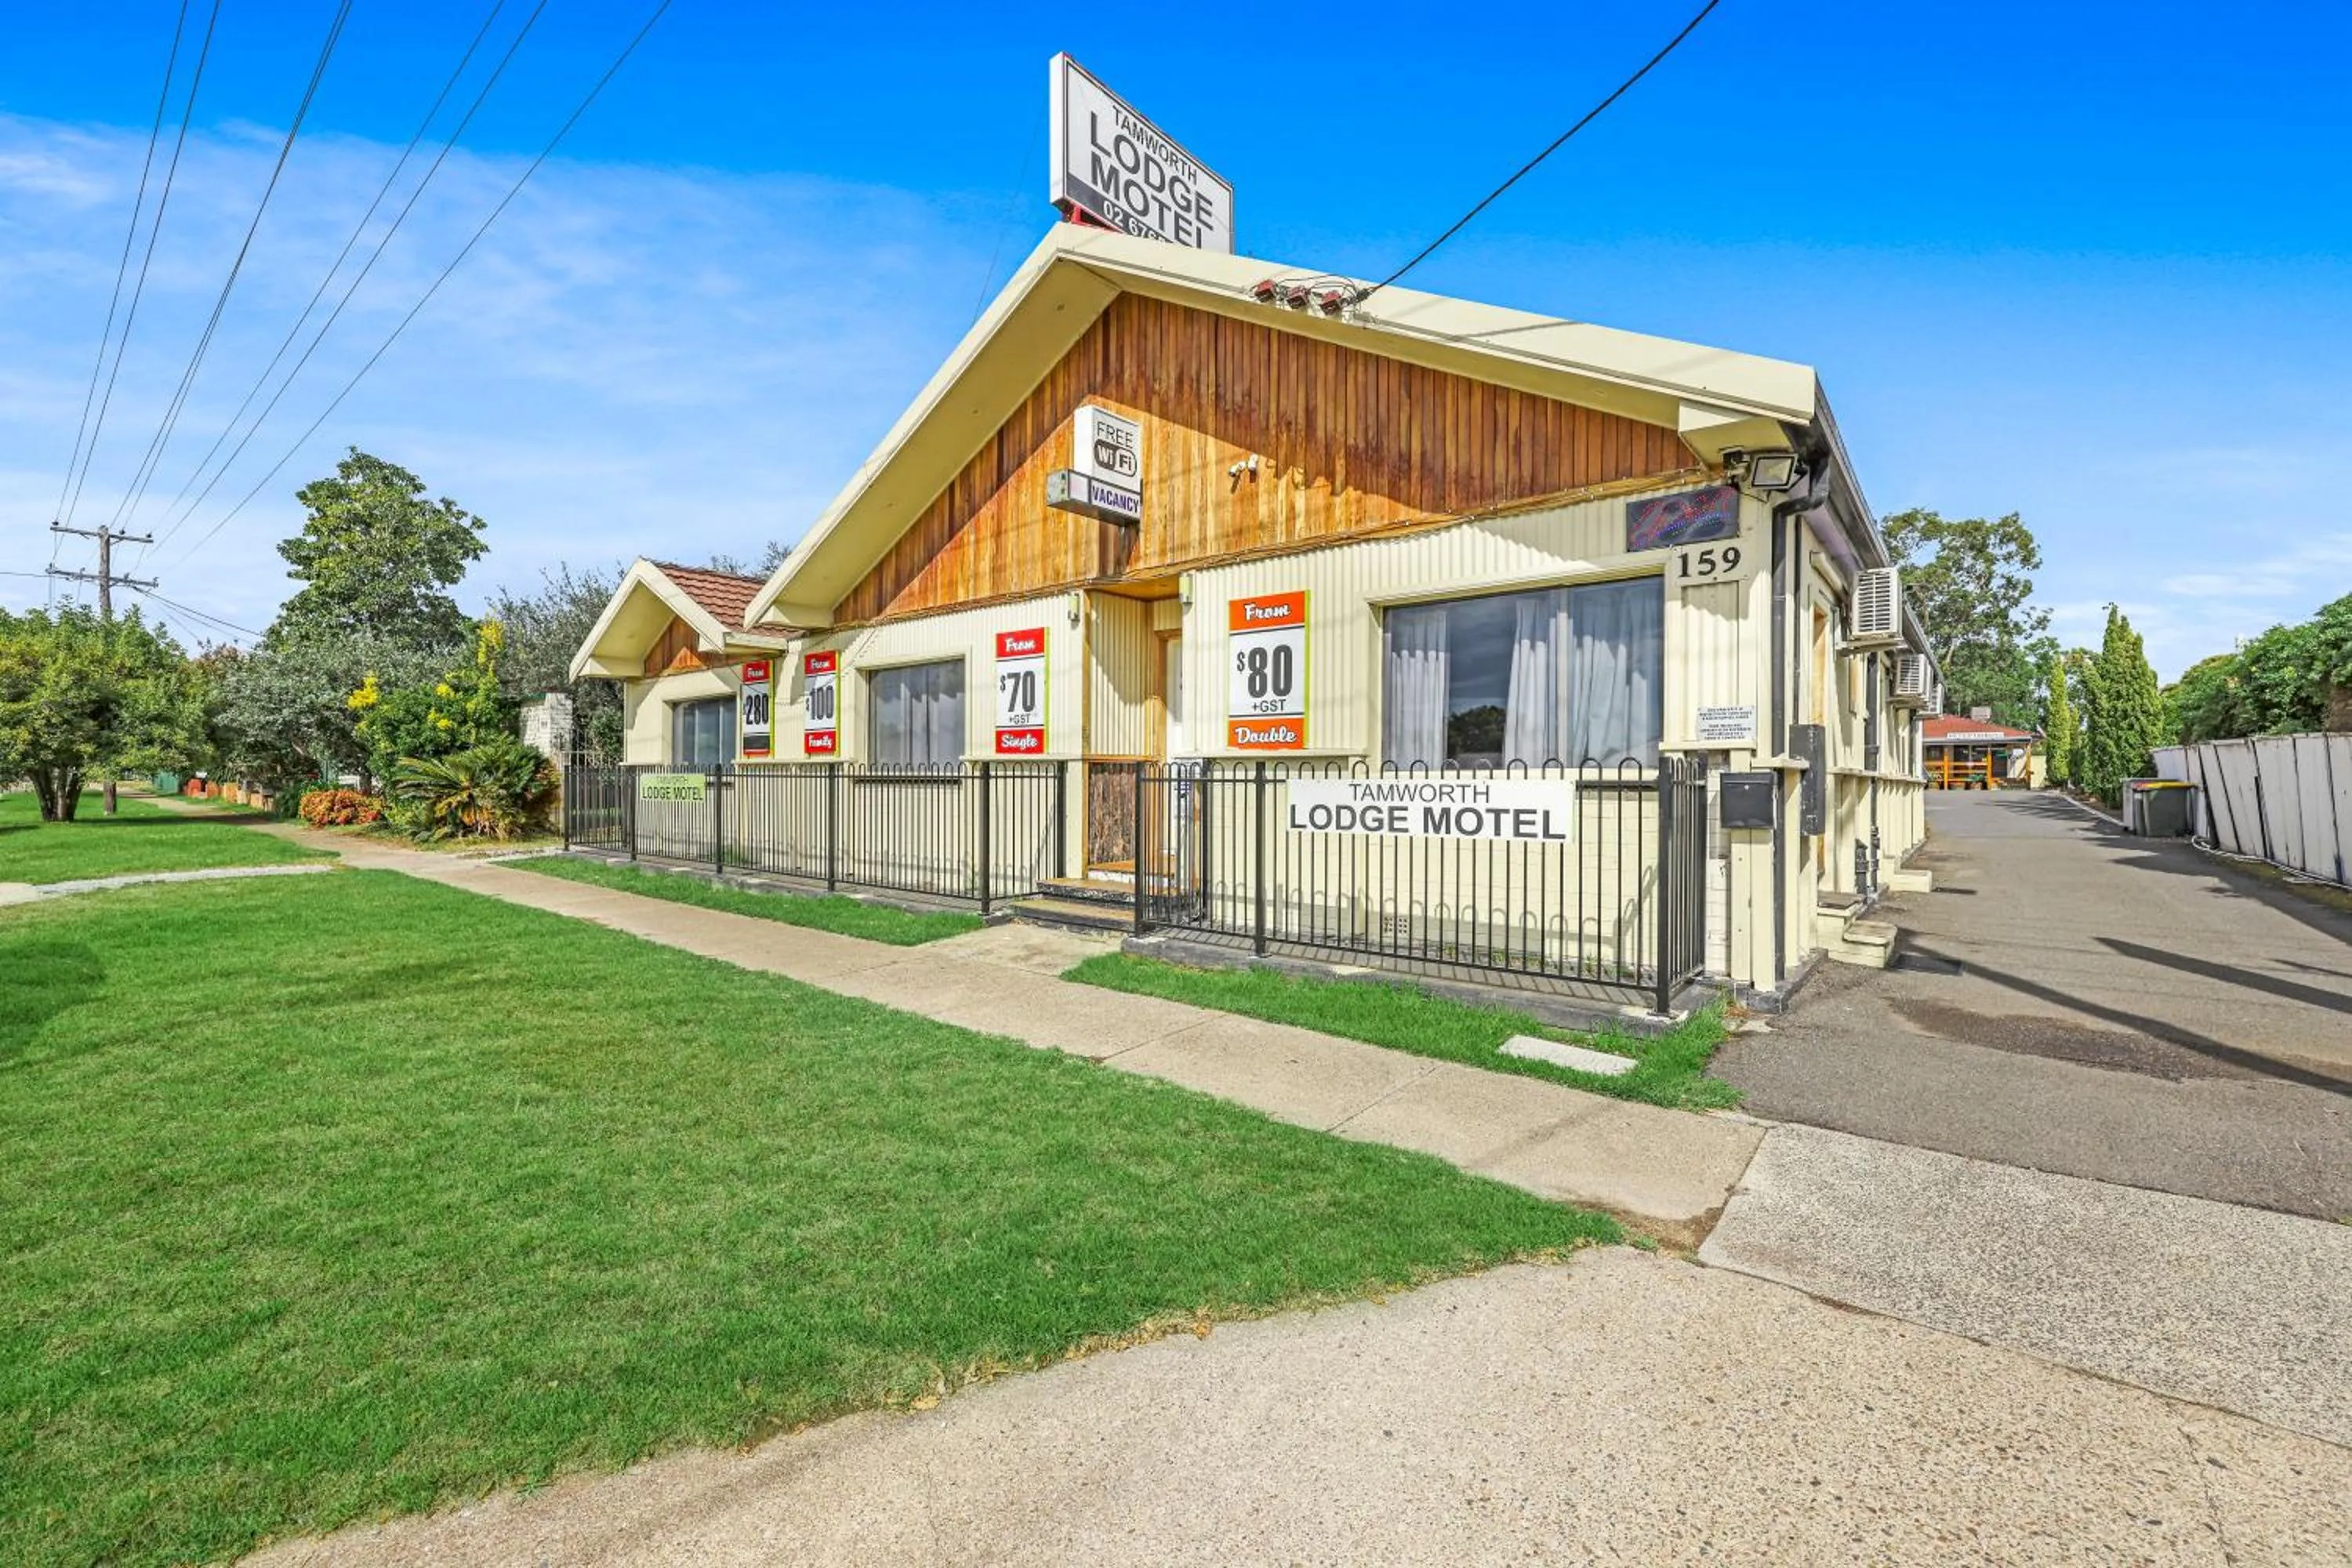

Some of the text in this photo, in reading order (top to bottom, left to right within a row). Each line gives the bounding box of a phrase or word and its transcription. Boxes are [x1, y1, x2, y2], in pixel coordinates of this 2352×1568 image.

[1112, 105, 1198, 186] TAMWORTH
[1090, 111, 1214, 232] LODGE
[1103, 200, 1123, 227] 02
[1097, 421, 1134, 449] FREE
[1092, 485, 1140, 513] VACANCY
[1678, 546, 1741, 579] 159
[1243, 602, 1292, 622] From
[1004, 637, 1036, 652] From
[1236, 644, 1293, 699] $80
[805, 685, 833, 720] $100
[1000, 670, 1036, 713] $70
[1009, 713, 1032, 724] +GST
[1251, 699, 1287, 713] +GST
[1001, 733, 1039, 750] Single
[1234, 727, 1298, 745] Double
[642, 786, 703, 800] LODGE MOTEL
[1349, 783, 1490, 804] TAMWORTH
[1290, 804, 1566, 840] LODGE MOTEL
